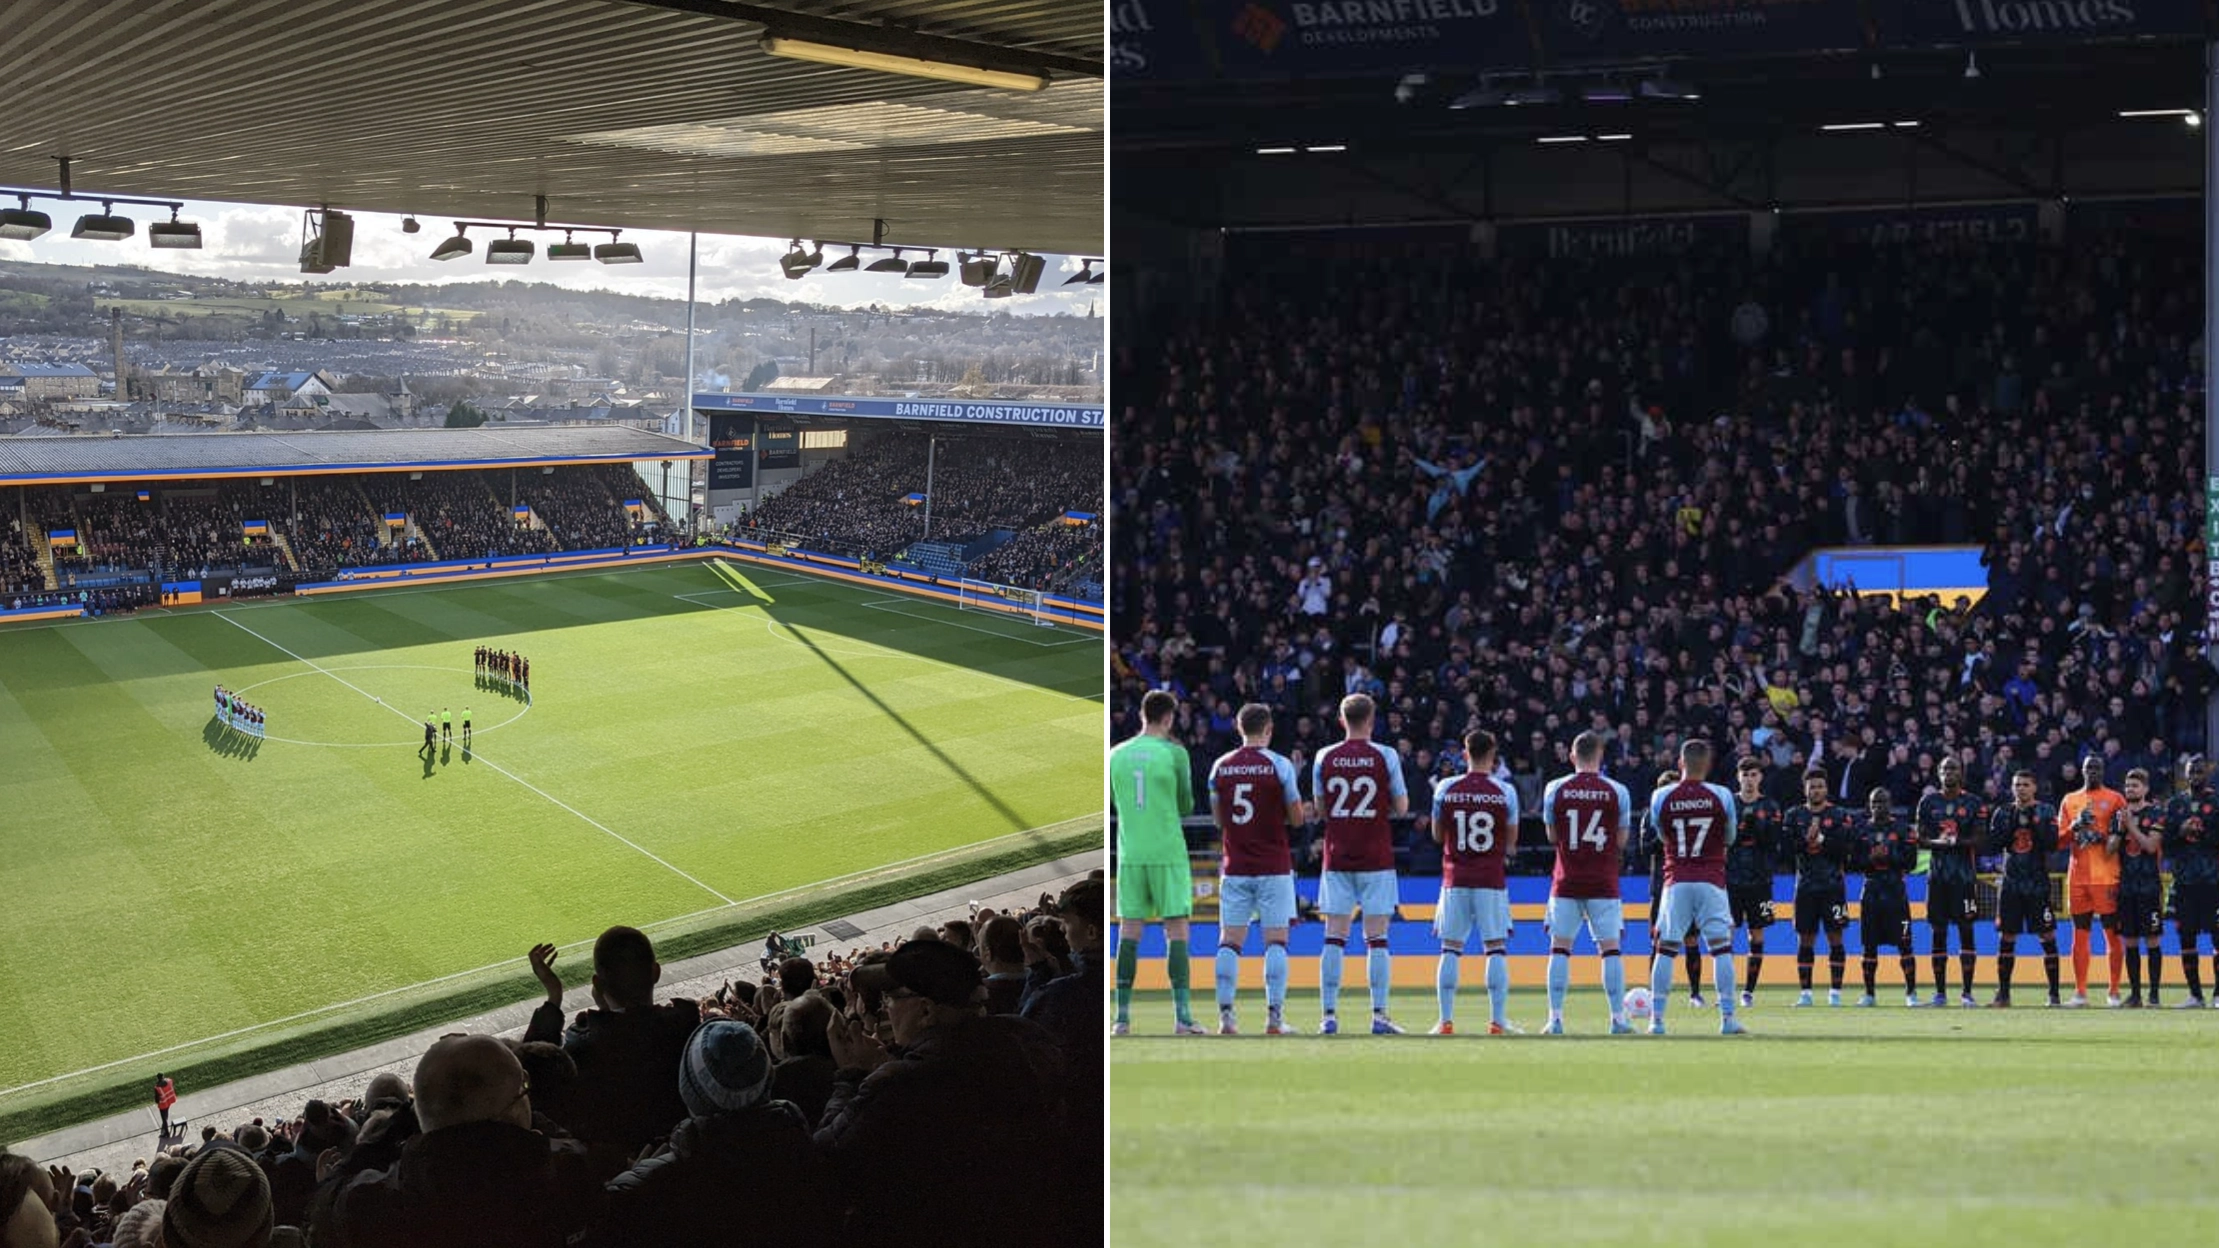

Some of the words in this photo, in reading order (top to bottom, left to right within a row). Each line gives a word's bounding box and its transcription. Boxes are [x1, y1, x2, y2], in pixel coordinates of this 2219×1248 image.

[1291, 0, 1498, 26] BARNFIELD
[1958, 0, 2136, 31] Homes
[896, 403, 963, 418] BARNFIELD
[966, 406, 1077, 423] CONSTRUCTION
[713, 439, 749, 447] BARNFIELD
[1333, 757, 1375, 768] COLLINS
[1133, 768, 1143, 810] 1
[1327, 776, 1378, 818] 22
[1563, 789, 1610, 801] ROBERTS
[1232, 783, 1252, 824] 5
[1670, 799, 1713, 811] LENNON
[1454, 810, 1495, 852] 18
[1566, 809, 1608, 851] 14
[1672, 816, 1714, 858] 17
[1963, 899, 1977, 913] 14
[2044, 906, 2052, 921] 6
[1902, 921, 1908, 935] 7
[2151, 912, 2159, 926] 5
